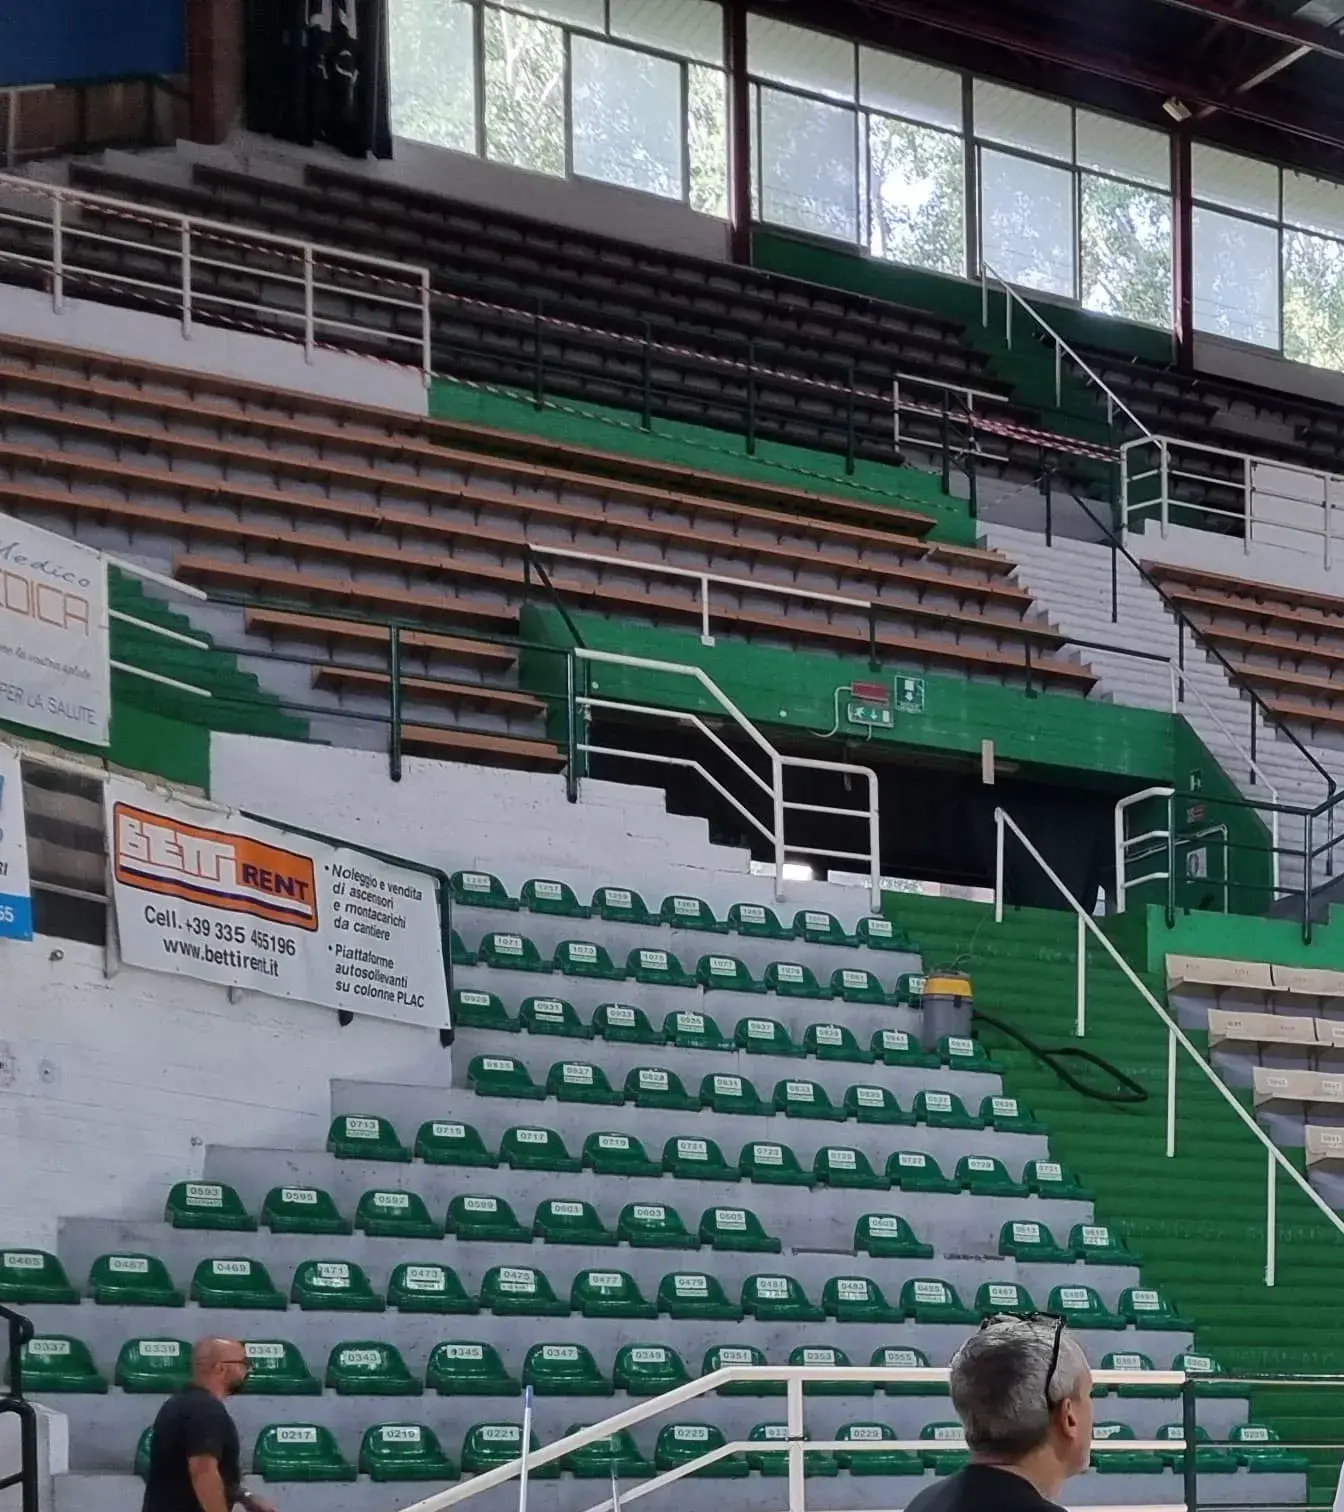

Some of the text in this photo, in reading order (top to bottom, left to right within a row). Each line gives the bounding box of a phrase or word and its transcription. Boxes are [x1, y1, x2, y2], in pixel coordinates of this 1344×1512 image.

[0, 569, 89, 635] DICA
[48, 697, 97, 726] SALUTE
[242, 863, 309, 901] RENT
[331, 864, 423, 901] Noleggio e vendita
[332, 882, 394, 910] di ascensori
[333, 900, 406, 929] e montacarichi
[144, 905, 296, 957] Cell. +39 335 455196
[333, 916, 391, 941] da cantiere
[163, 938, 280, 978] www.bettirent.it
[335, 944, 394, 969] Piattaforme
[335, 963, 408, 988] autosollevanti
[335, 980, 425, 1008] su colonne PLAC
[350, 1119, 376, 1130] 0713
[436, 1126, 462, 1135] 0715
[602, 1138, 627, 1147] 0719
[190, 1186, 219, 1197] 0593
[285, 1191, 313, 1201] 0595
[467, 1200, 494, 1210] 0599
[8, 1256, 40, 1266] 0465
[216, 1263, 246, 1273] 0469
[410, 1268, 440, 1278] 0473
[503, 1270, 531, 1280] 0475
[347, 1353, 377, 1362] 0343
[547, 1348, 574, 1357] 0347
[888, 1352, 913, 1361] 0355
[281, 1430, 310, 1440] 0217
[387, 1430, 415, 1440] 0219
[486, 1429, 514, 1438] 0221
[678, 1429, 703, 1438] 0225
[853, 1429, 879, 1438] 0229
